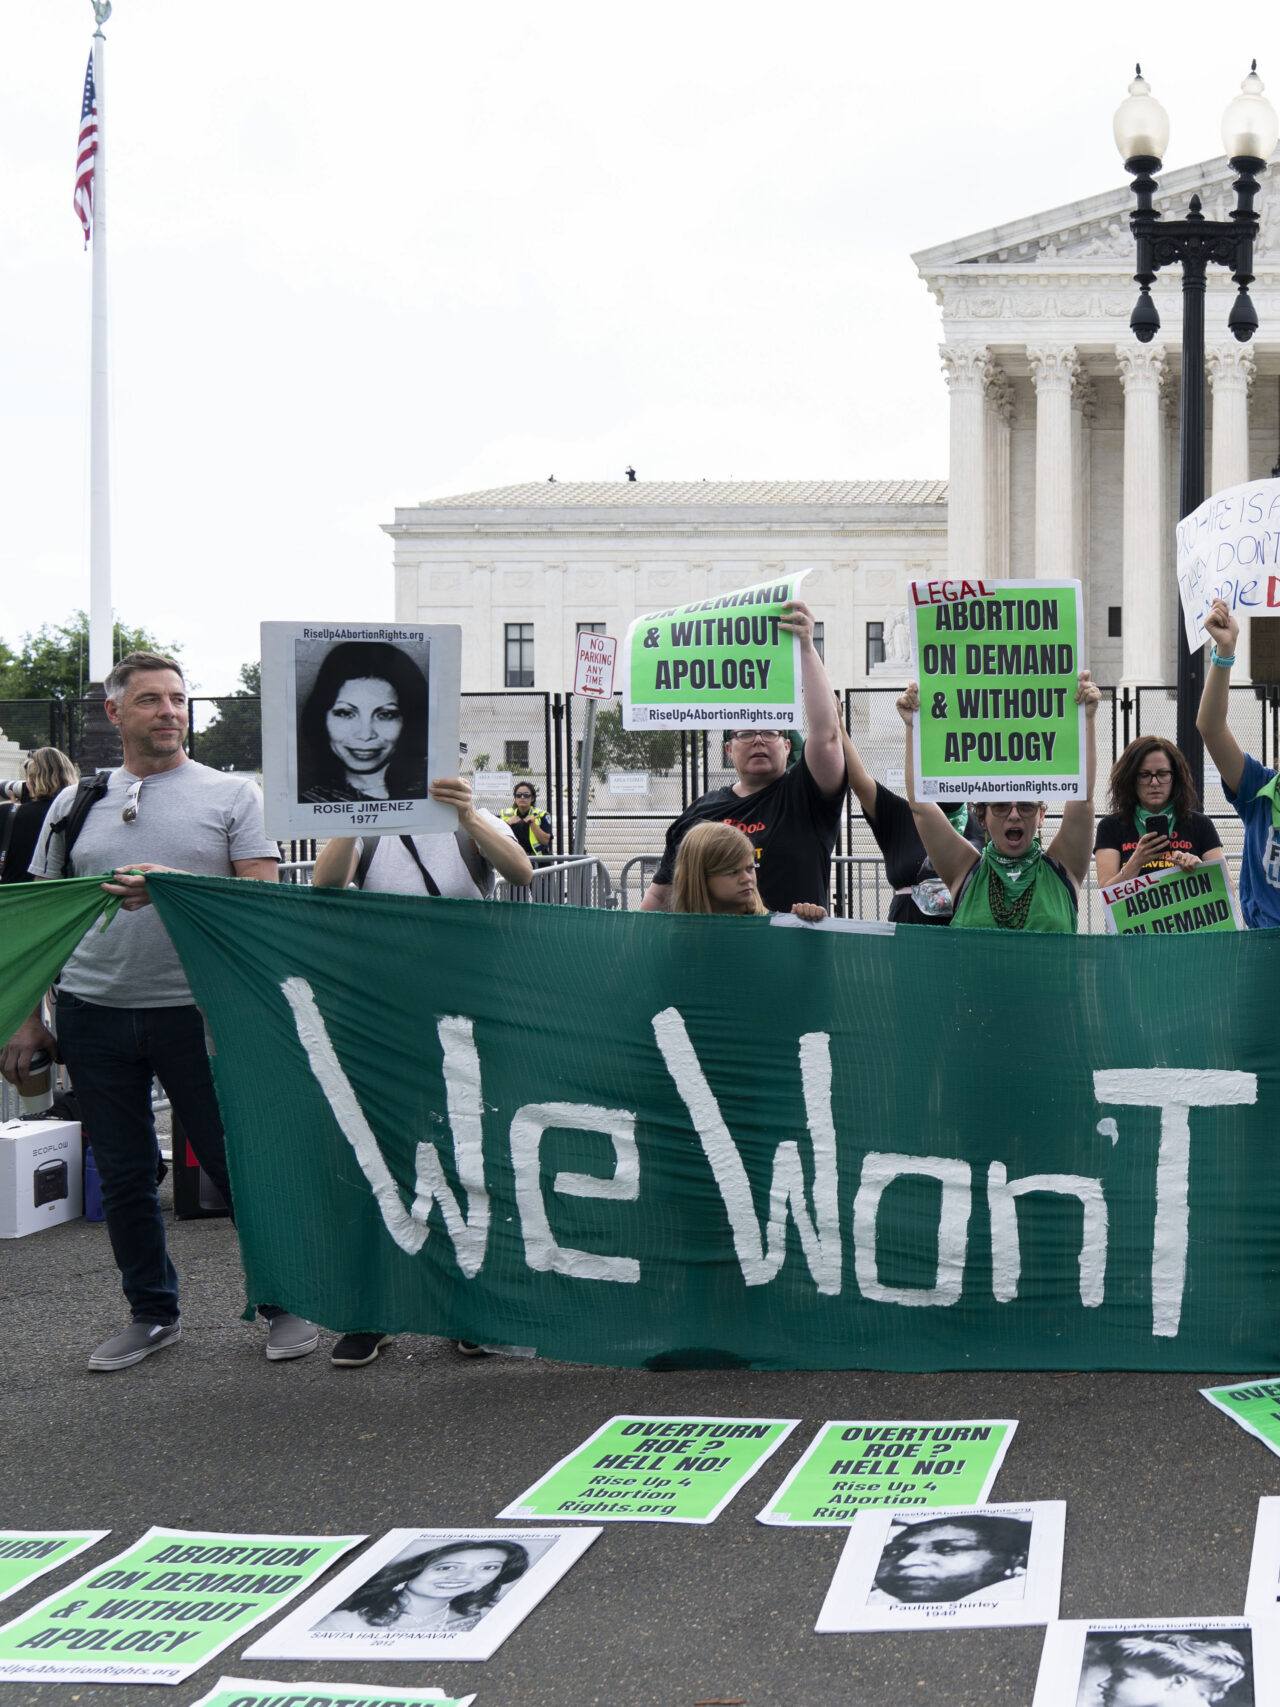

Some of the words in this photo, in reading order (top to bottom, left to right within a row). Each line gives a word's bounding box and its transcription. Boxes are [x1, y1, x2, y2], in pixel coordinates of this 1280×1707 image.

[684, 584, 789, 615] DEMAND
[911, 580, 995, 605] LEGAL
[936, 600, 1059, 631] ABORTION
[304, 629, 424, 641] RiseUp4AbortionRights.org
[644, 627, 660, 648] &
[671, 616, 781, 646] WITHOUT
[590, 639, 604, 651] NO
[580, 650, 612, 666] PARKING
[923, 644, 956, 675] ON
[966, 644, 1073, 675] DEMAND
[587, 665, 603, 674] ANY
[655, 659, 771, 690] APOLOGY
[585, 675, 603, 686] TIME
[931, 692, 947, 719] &
[957, 688, 1067, 718] WITHOUT
[650, 709, 794, 722] RiseUp4AbortionRights.org
[945, 731, 1056, 763] APOLOGY
[939, 781, 1078, 794] RiseUp4AbortionRights.org
[314, 804, 354, 814] ROSIE
[358, 802, 413, 813] JIMENEZ
[350, 815, 378, 824] 1977
[1102, 873, 1160, 904] LEGAL
[1126, 873, 1212, 918] ABORTION
[1152, 899, 1230, 934] DEMAND
[280, 975, 641, 1283] We
[33, 1141, 68, 1157] ECOFLOW
[621, 1423, 771, 1439] OVERTURN
[841, 1427, 992, 1441] OVERTURN
[633, 1439, 697, 1453] ROE
[699, 1440, 725, 1454] ?
[862, 1444, 923, 1457] ROE
[929, 1444, 952, 1458] ?
[593, 1455, 665, 1471] HELL
[673, 1457, 732, 1472] NO!
[829, 1460, 901, 1475] HELL
[912, 1460, 967, 1475] NO!
[589, 1476, 637, 1486] Rise
[643, 1477, 672, 1488] Up
[678, 1478, 692, 1486] 4
[832, 1482, 881, 1491] Rise
[888, 1482, 917, 1493] Up
[922, 1482, 937, 1491] 4
[578, 1488, 676, 1500] Abortion
[827, 1494, 927, 1505] Abortion
[557, 1501, 677, 1515] Rights.org
[145, 1545, 322, 1567] ABORTION
[86, 1570, 151, 1590] ON
[142, 1572, 303, 1595] DEMAND
[50, 1600, 88, 1619] &
[88, 1599, 259, 1622] WITHOUT
[889, 1603, 943, 1611] Pauline
[949, 1601, 999, 1610] Shirley
[14, 1628, 202, 1653] APOLOGY
[309, 1631, 355, 1640] SAVITA
[356, 1632, 458, 1640] HALAPPANAVAR
